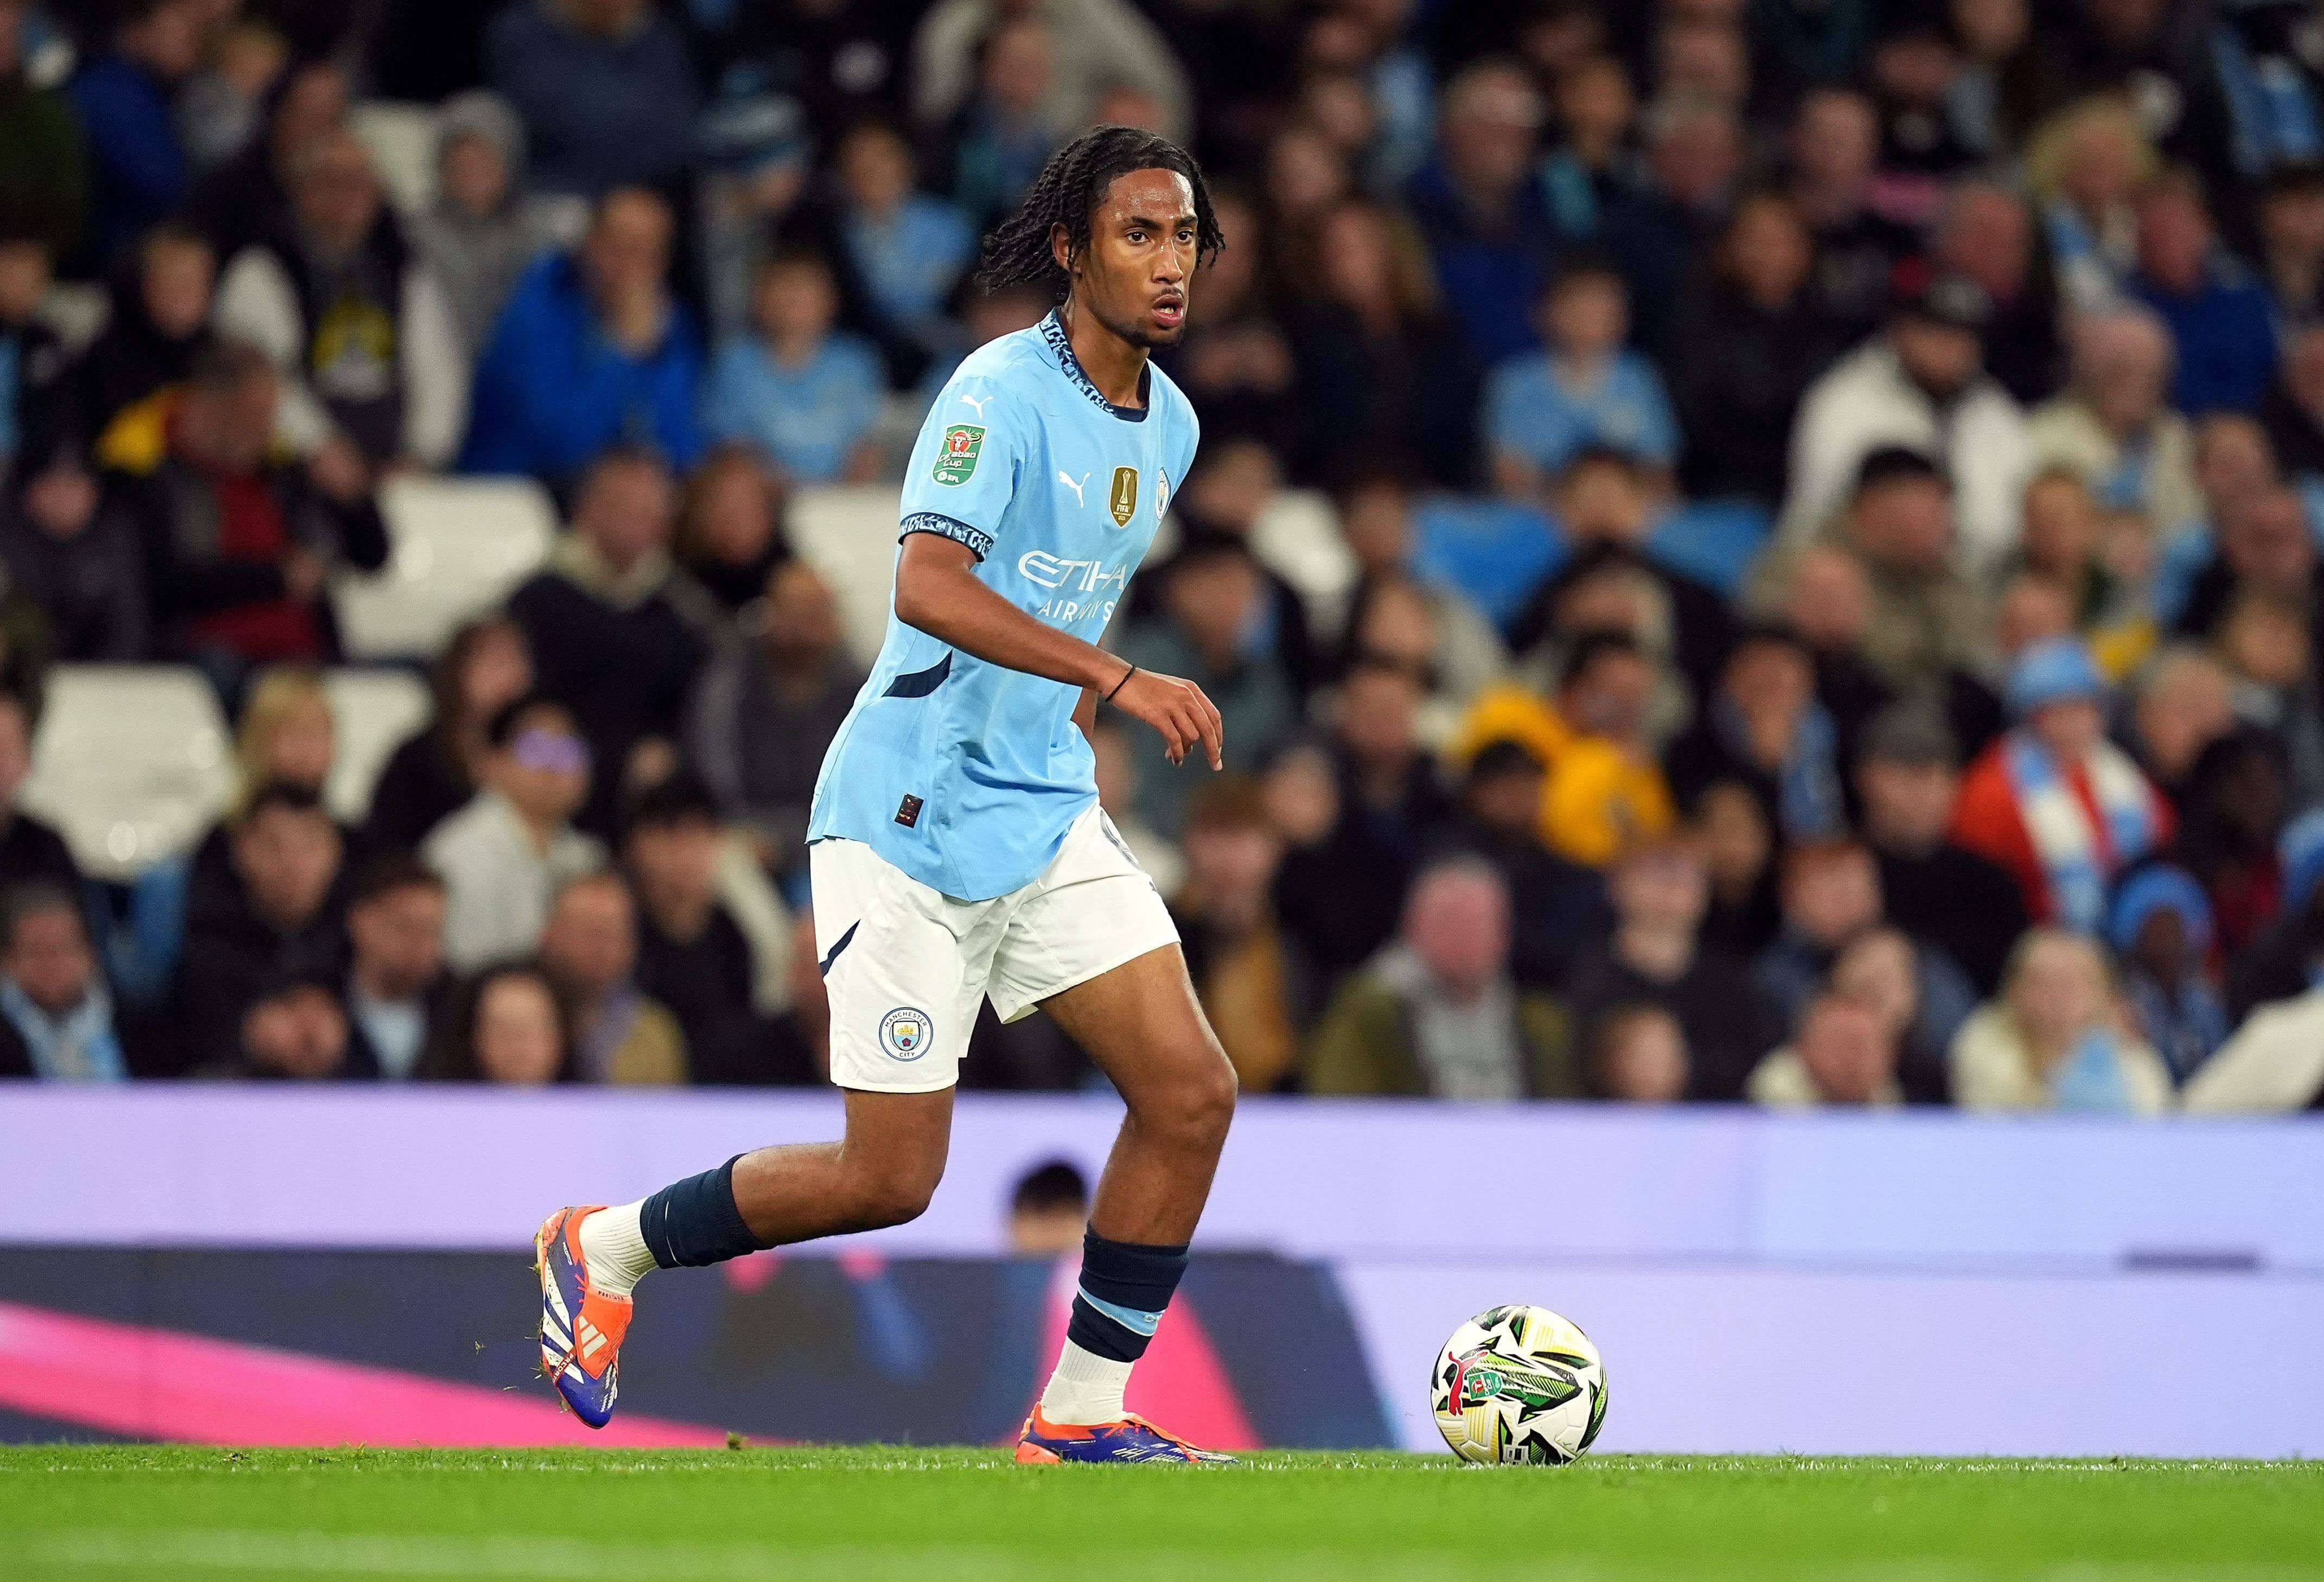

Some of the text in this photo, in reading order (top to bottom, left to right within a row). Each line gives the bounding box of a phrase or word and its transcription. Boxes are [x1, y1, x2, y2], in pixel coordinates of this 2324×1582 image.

[943, 459, 962, 468] Cup
[1116, 505, 1129, 513] FIFA
[1018, 550, 1127, 592] ETIHA
[885, 1012, 927, 1028] MANCHESTER
